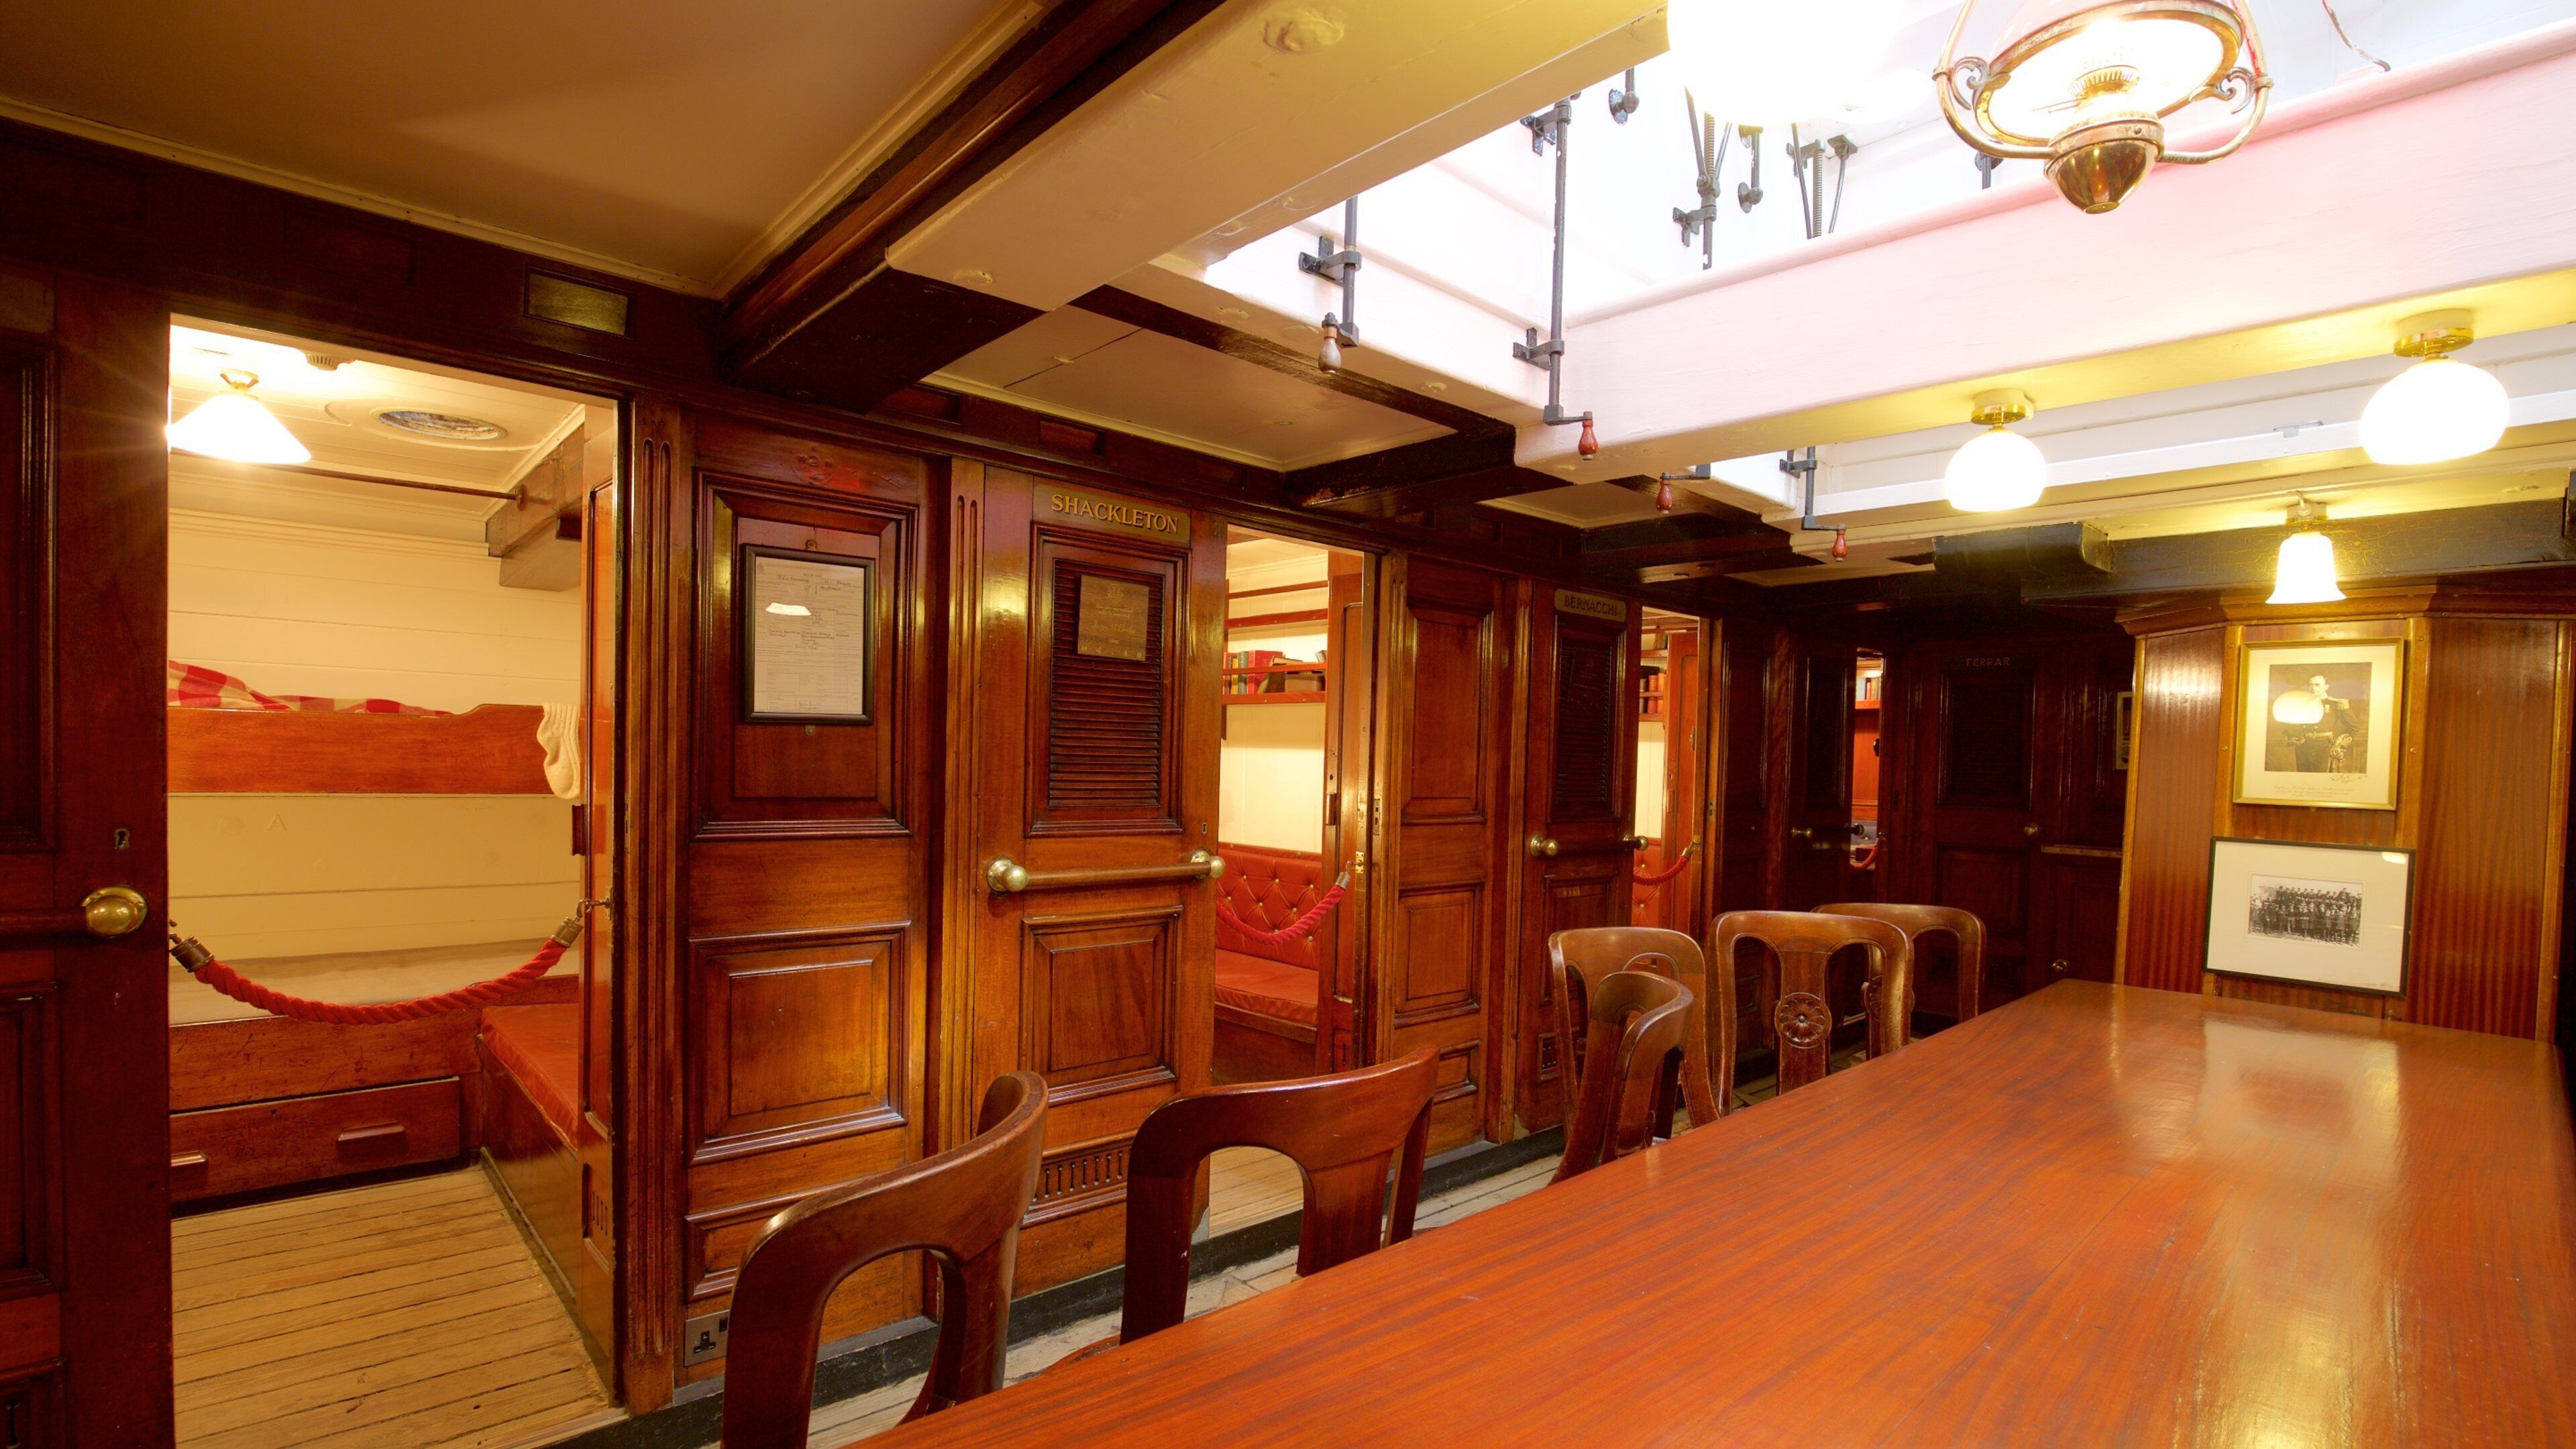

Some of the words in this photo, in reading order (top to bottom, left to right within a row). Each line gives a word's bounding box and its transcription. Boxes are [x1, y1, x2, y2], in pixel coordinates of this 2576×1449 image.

[1051, 494, 1179, 533] SHACKLETON
[1563, 595, 1617, 616] BERNACCHI
[1966, 657, 2010, 666] FERRAR
